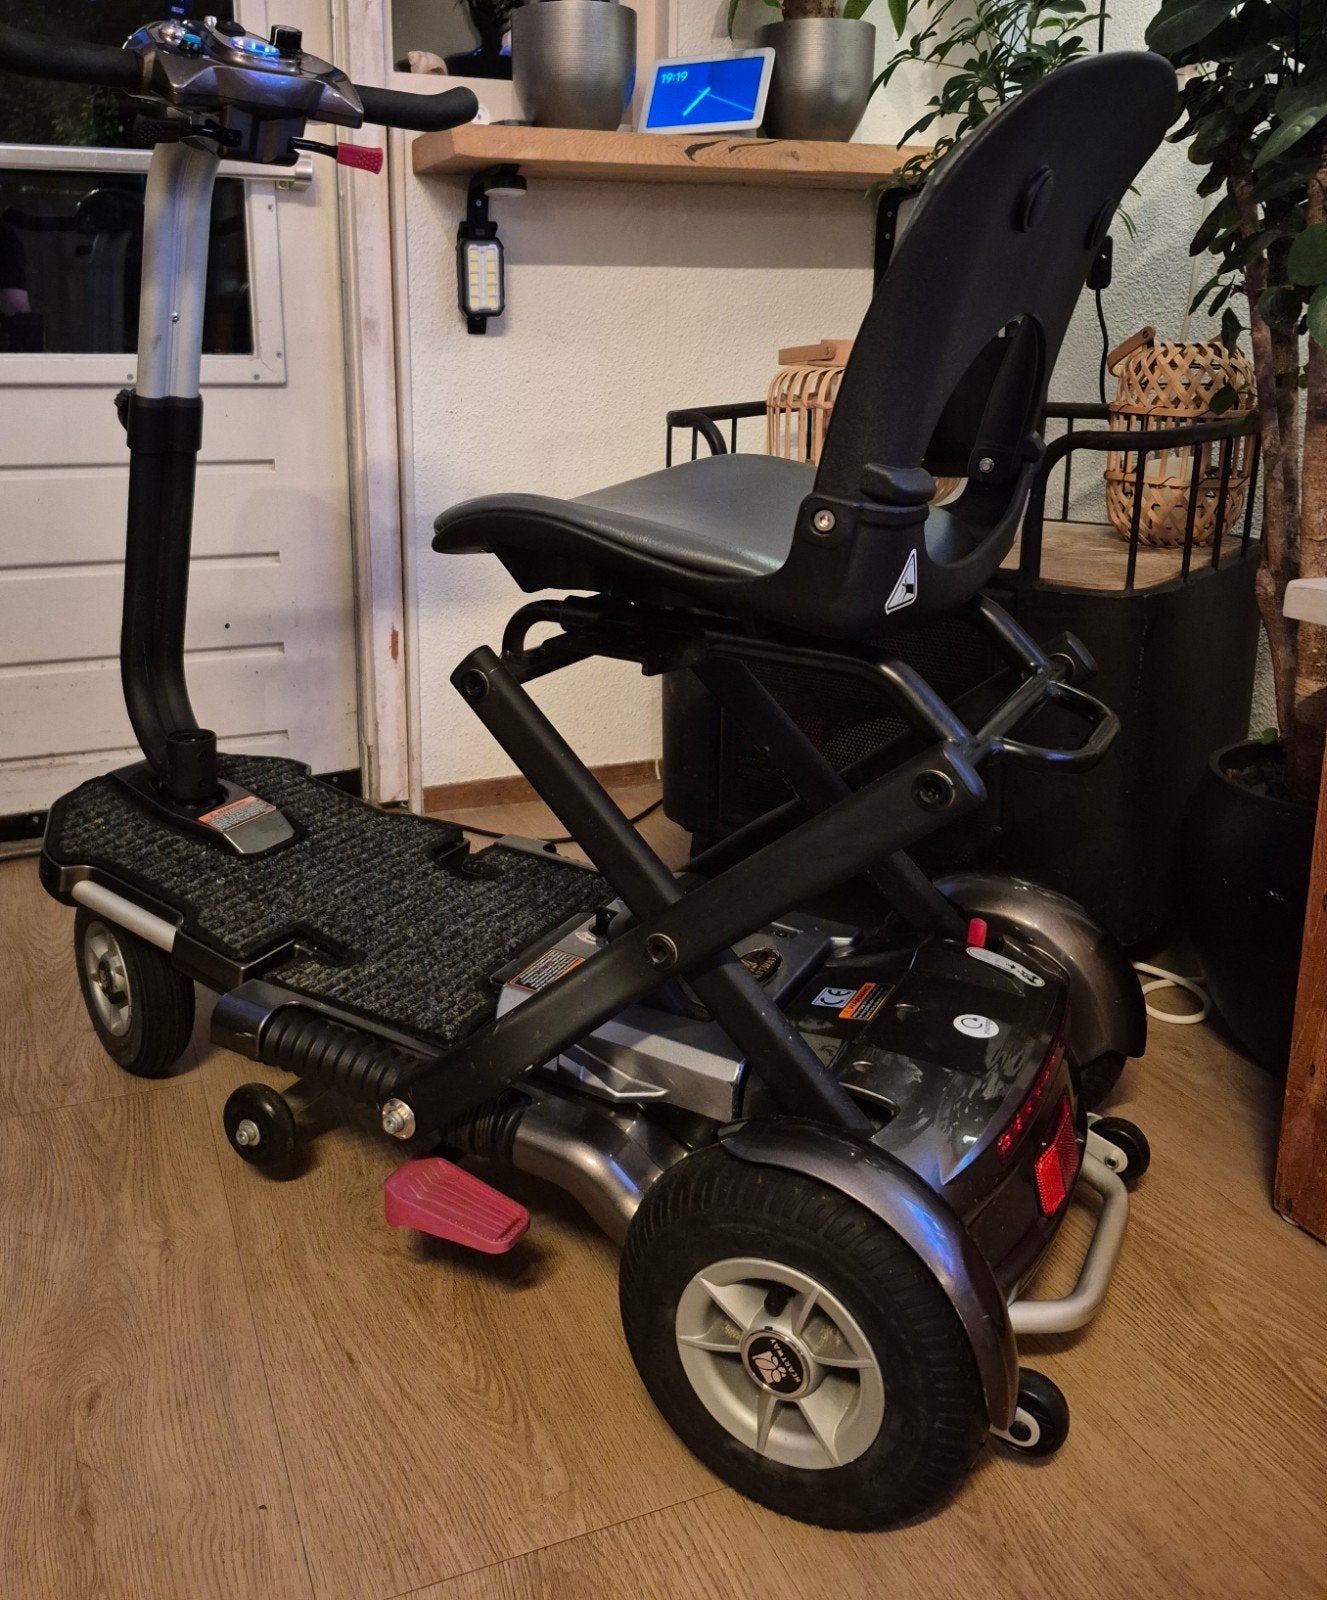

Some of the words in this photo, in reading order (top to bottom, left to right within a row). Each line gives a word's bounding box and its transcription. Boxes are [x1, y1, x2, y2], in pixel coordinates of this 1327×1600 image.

[661, 71, 688, 84] 19:19
[820, 988, 852, 1005] CE
[769, 1339, 801, 1383] HEARTWAY
